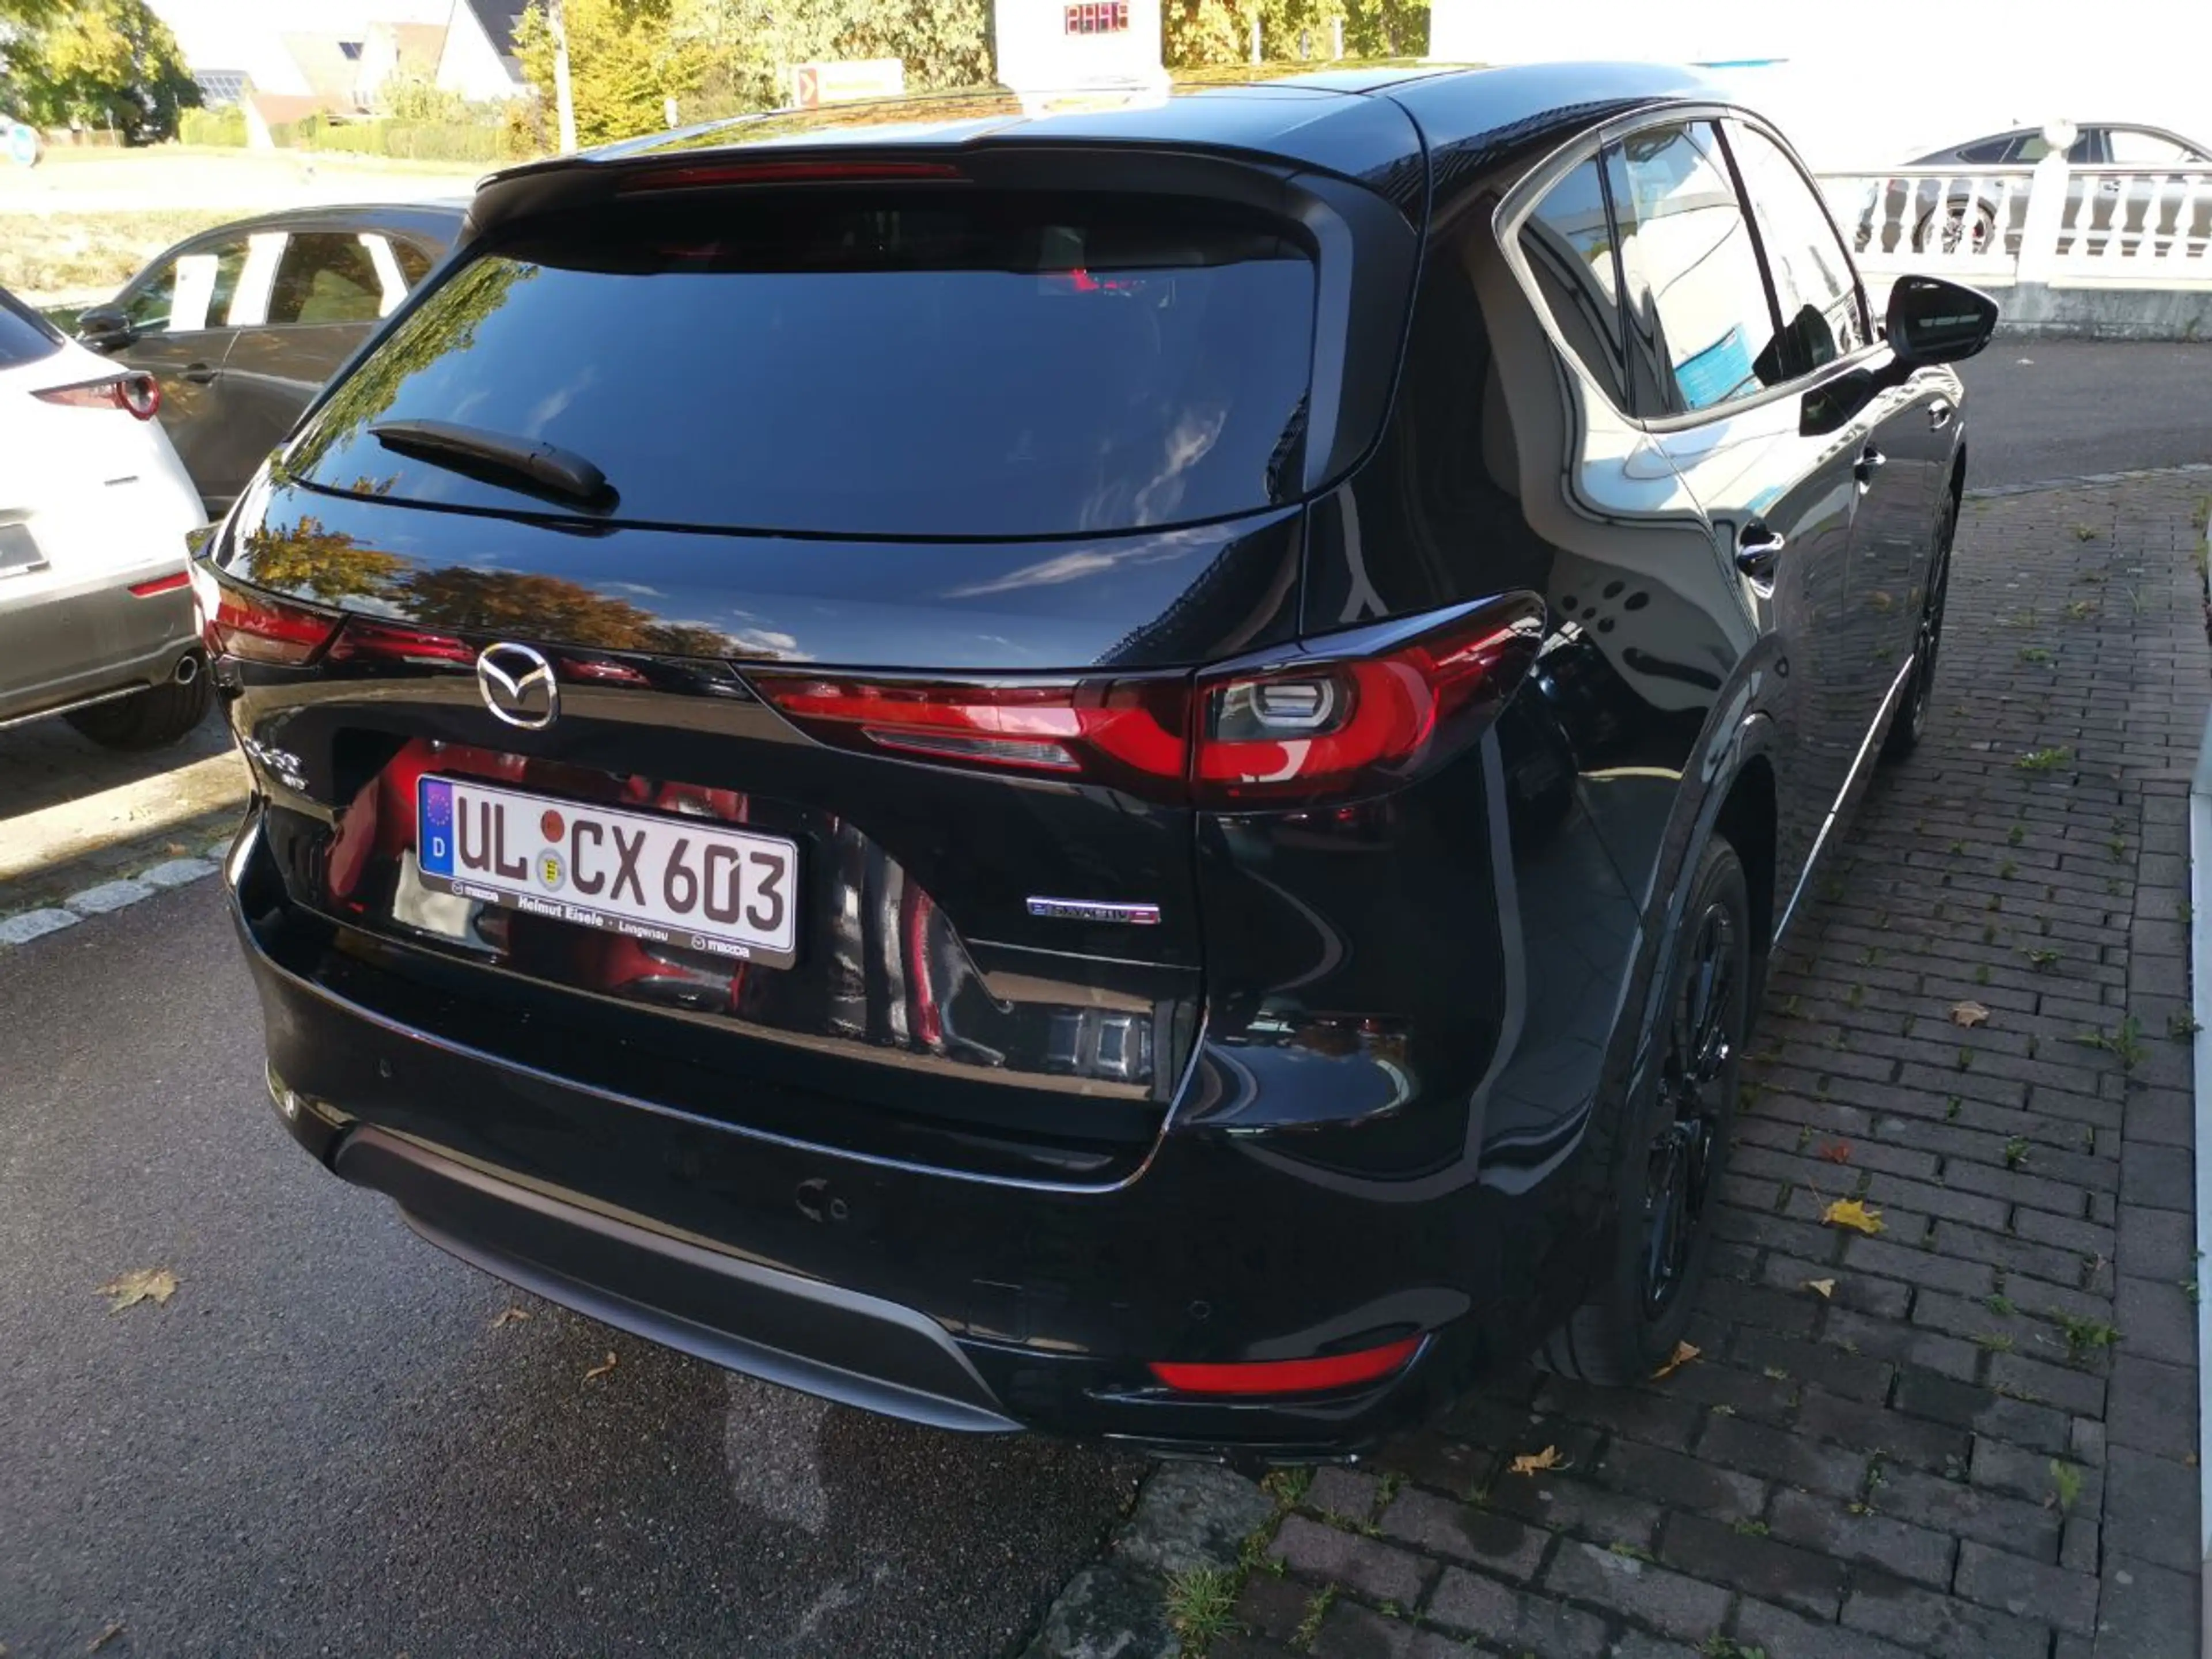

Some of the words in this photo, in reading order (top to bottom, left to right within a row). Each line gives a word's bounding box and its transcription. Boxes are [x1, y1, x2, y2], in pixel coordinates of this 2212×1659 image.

[433, 836, 445, 857] D
[458, 796, 528, 881] UL
[571, 820, 646, 906] CX
[664, 838, 785, 931] 603
[518, 895, 563, 916] Helmut
[565, 905, 604, 926] Eisele
